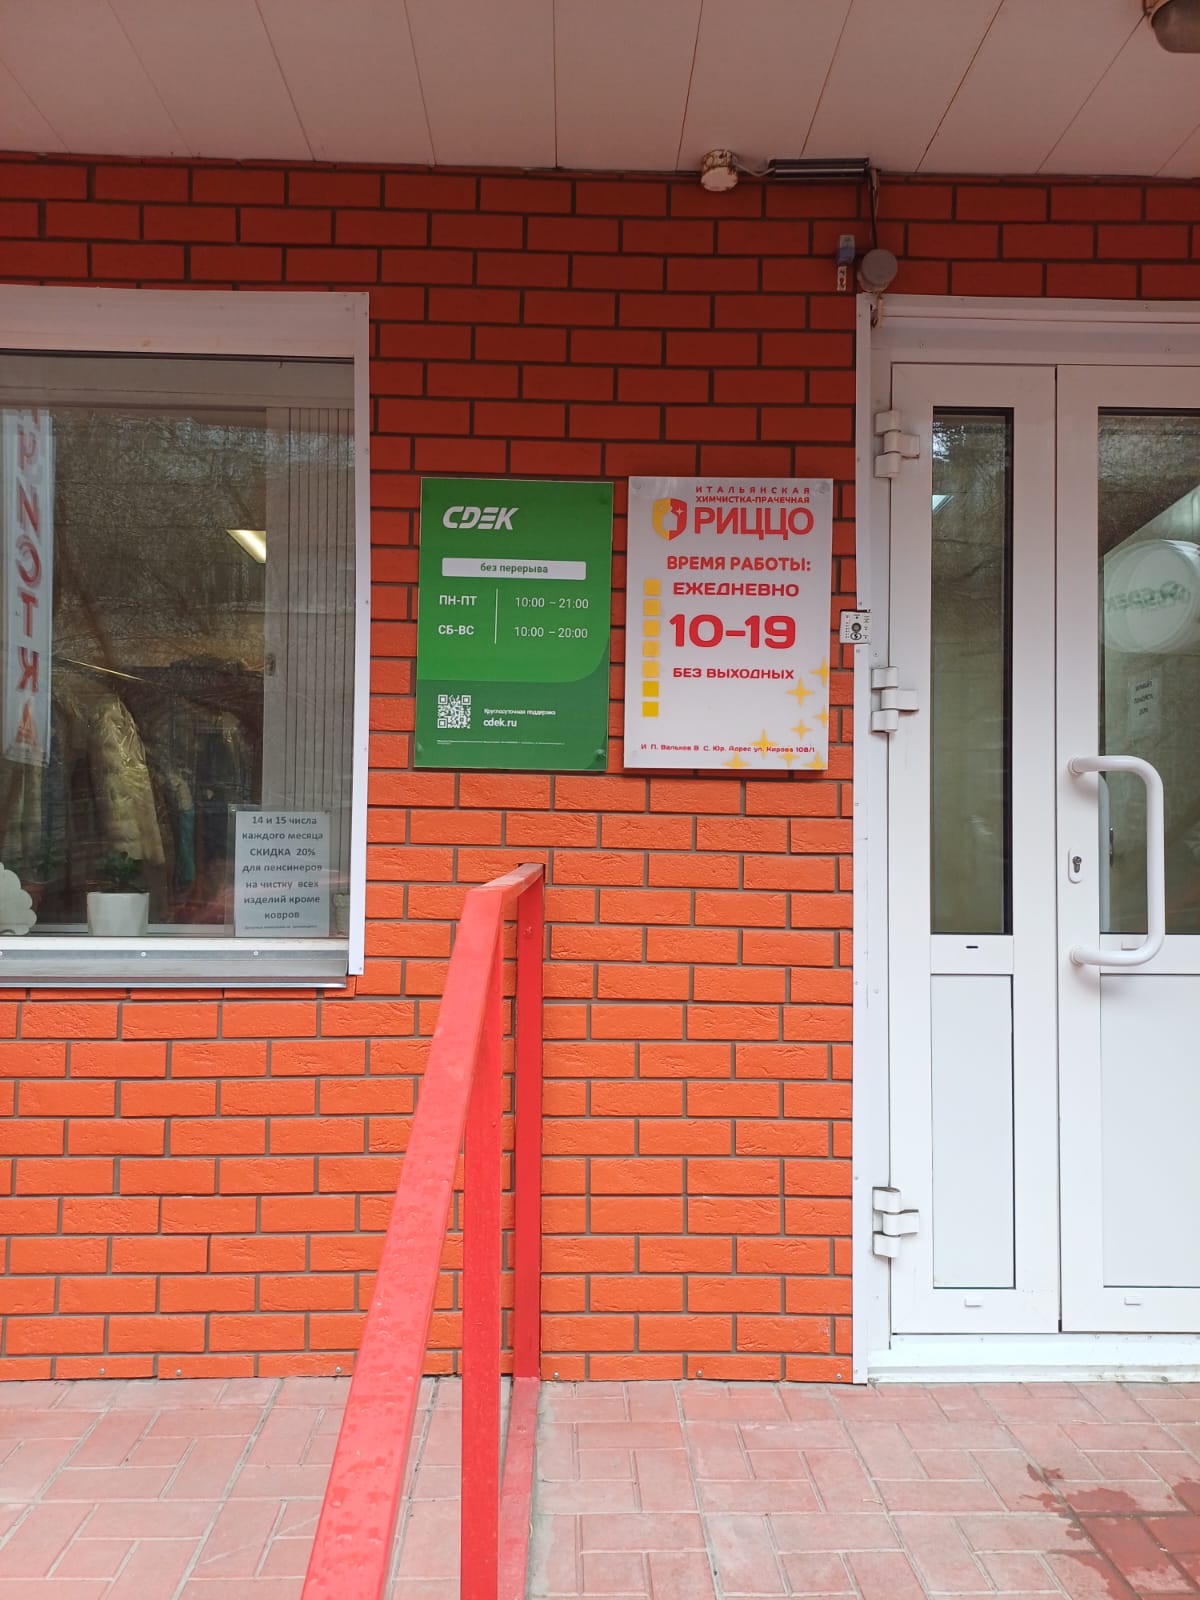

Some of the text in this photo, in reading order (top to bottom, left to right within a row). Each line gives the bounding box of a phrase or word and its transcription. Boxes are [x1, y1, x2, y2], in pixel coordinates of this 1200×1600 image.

[695, 485, 811, 496] ИТАЛЬЯНСКАЯ
[695, 496, 810, 505] ХИМЧИСТКА-ПРАЧЕЧНАЯ
[443, 506, 519, 531] CDEK
[694, 507, 815, 541] РИЦЦО
[480, 562, 549, 575] без перерыва
[667, 555, 811, 572] ВРЕМЯ РАБОТЫ:
[673, 582, 800, 598] ЕЖЕДНЕВНО
[439, 594, 478, 607] ПН-ПТ
[515, 597, 545, 608] 10:00
[558, 598, 589, 609] 21:00
[438, 624, 475, 636] СБ-ВС
[514, 626, 545, 638] 10:00
[558, 627, 588, 639] 20:00
[673, 667, 794, 680] БЕЗ ВЫХОДНЫХ
[483, 717, 518, 728] cdek.ru
[252, 816, 317, 825] 14 и 15 числа
[242, 832, 324, 841] каждого месяца
[249, 847, 317, 858] СКИДКА 20%
[242, 864, 261, 873] для
[245, 880, 319, 890] на чистку всех
[243, 895, 321, 905] изделий кроме
[264, 911, 300, 920] ковров
